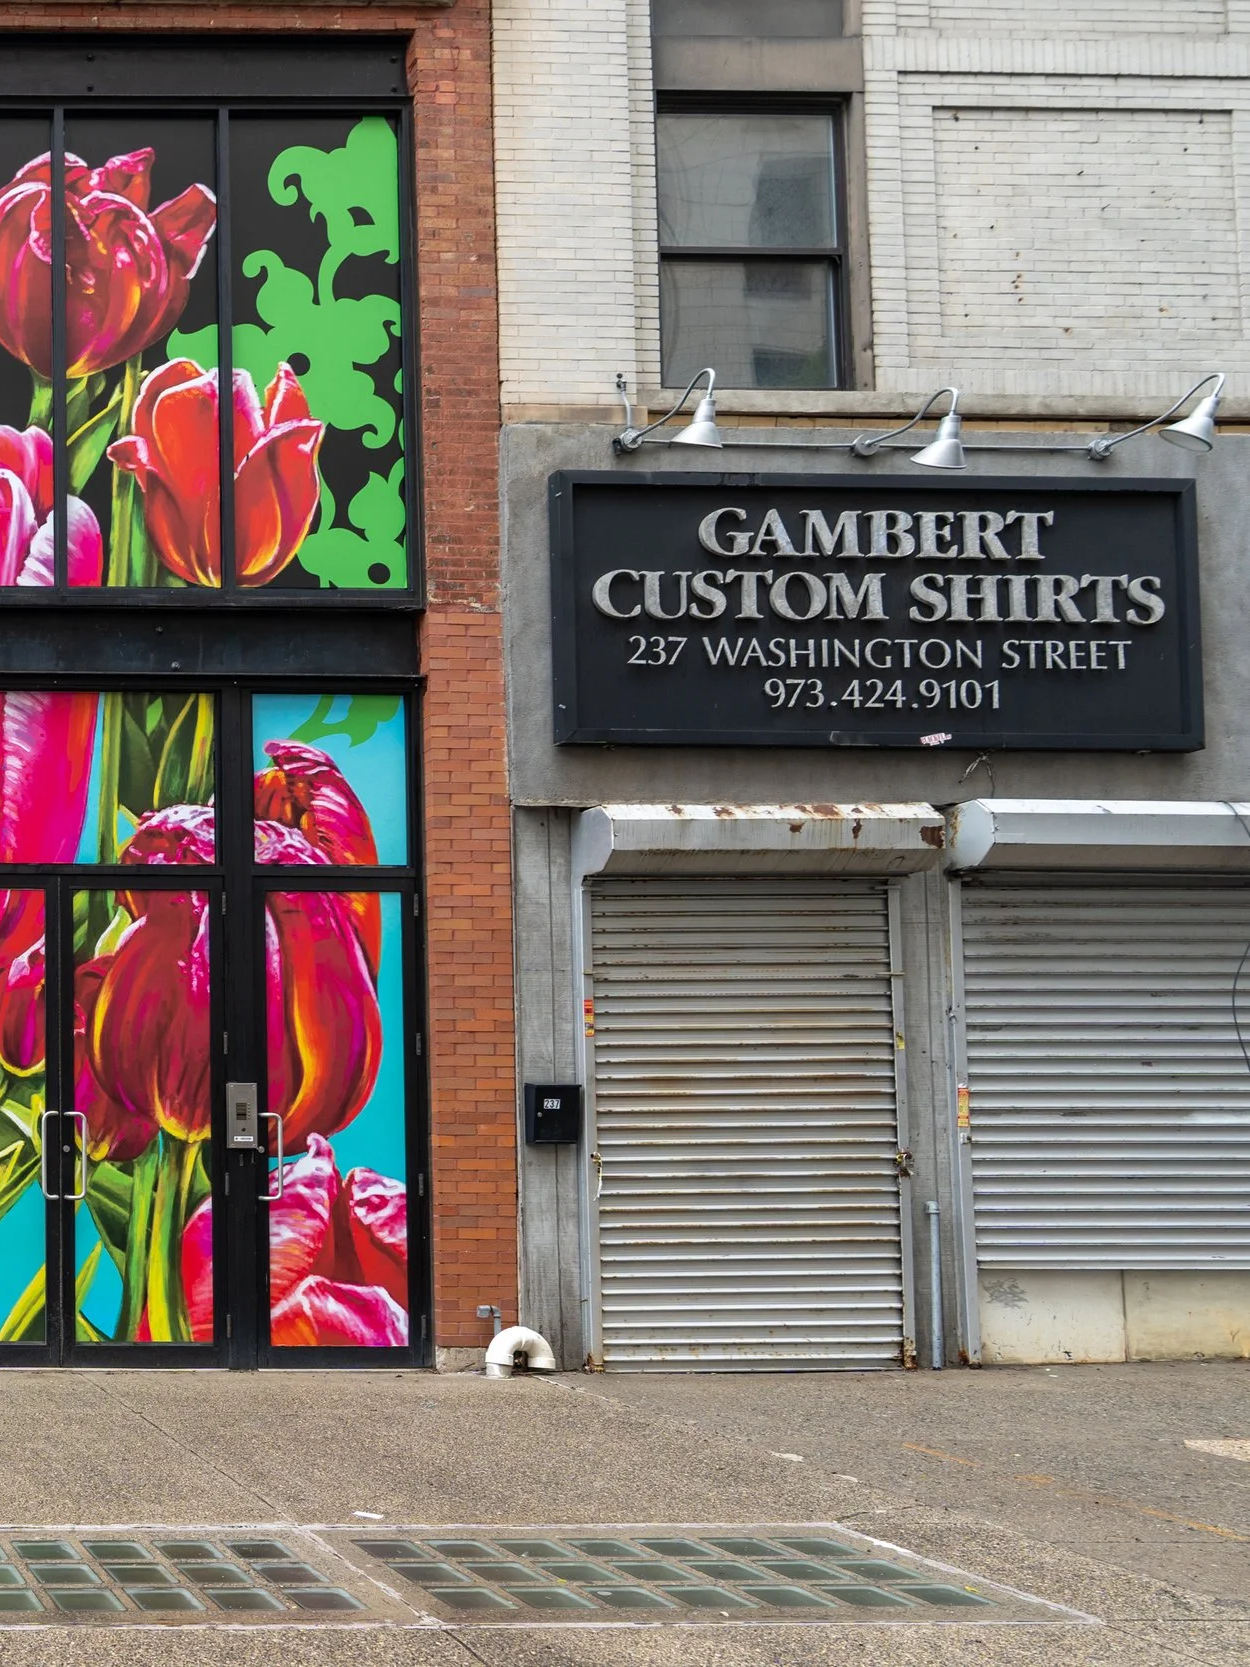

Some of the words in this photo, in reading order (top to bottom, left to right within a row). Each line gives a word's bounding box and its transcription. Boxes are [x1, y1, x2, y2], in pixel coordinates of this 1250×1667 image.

[698, 507, 1054, 560] GAMBERT
[592, 568, 890, 621] CUSTOM
[909, 573, 1166, 625] SHIRTS
[627, 635, 688, 666] 237
[702, 636, 983, 669] WASHINGTON
[1001, 639, 1132, 670] STREET
[764, 678, 1000, 709] 973.424.9101
[544, 1099, 560, 1109] 237
